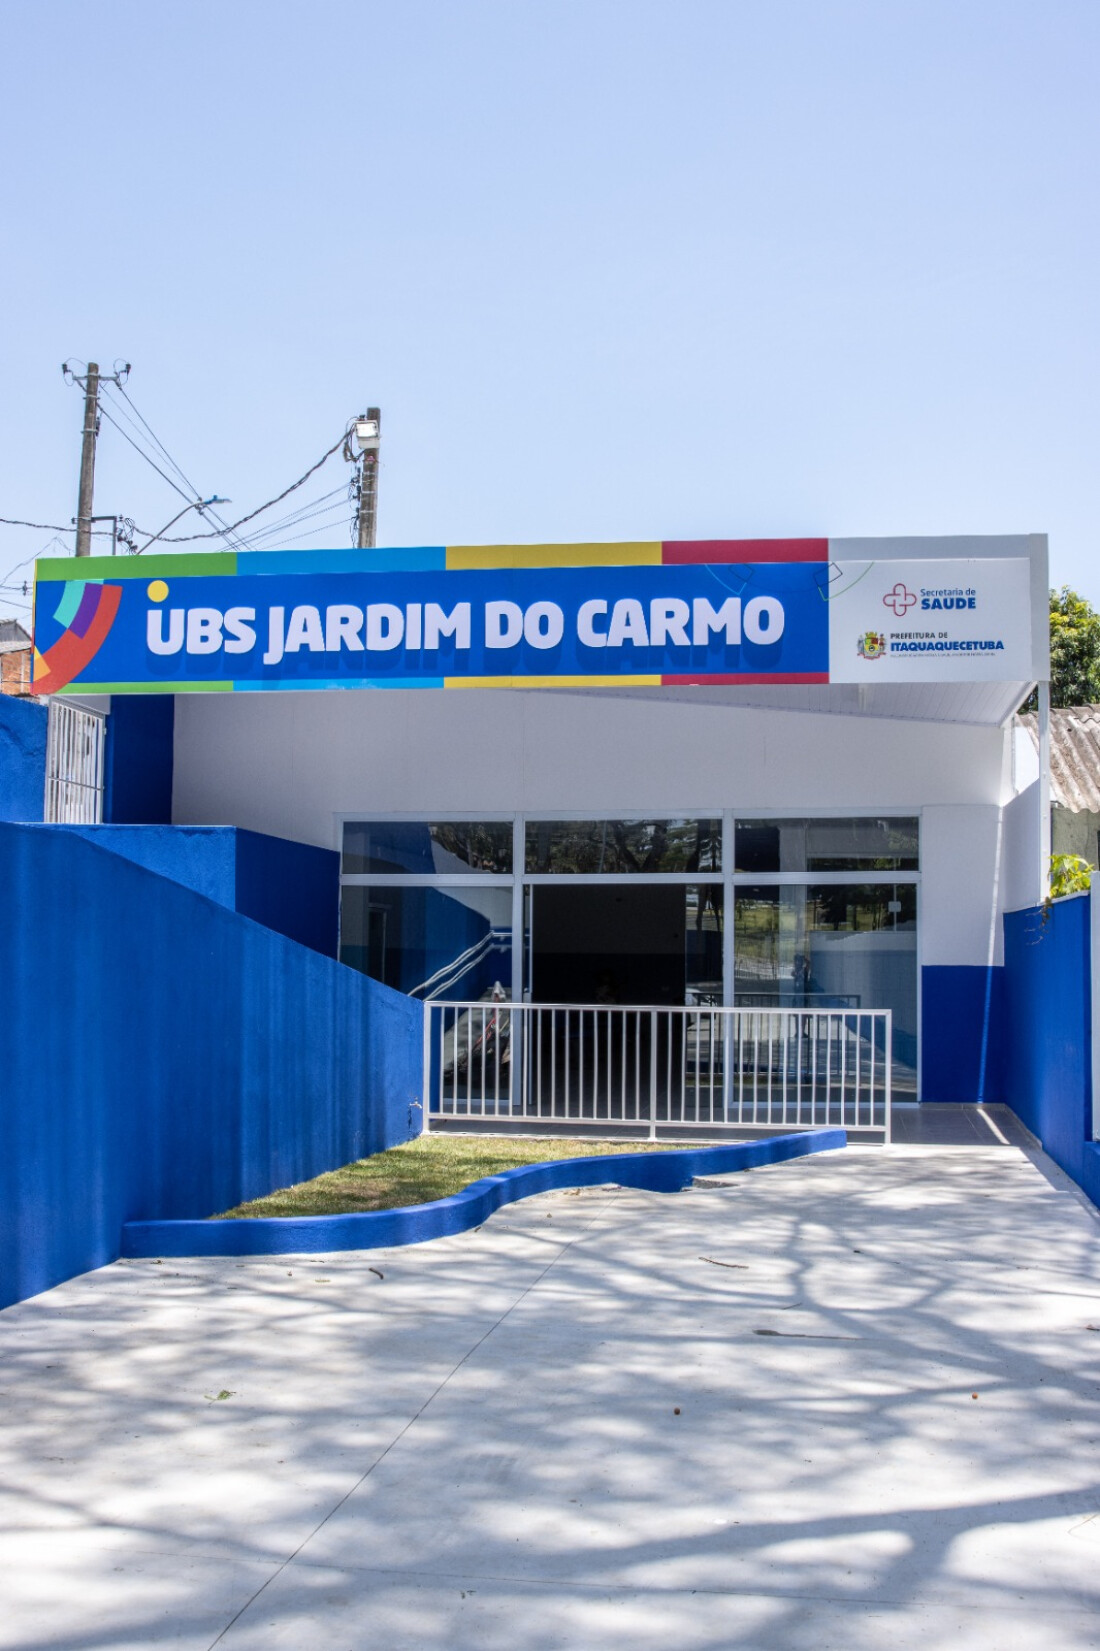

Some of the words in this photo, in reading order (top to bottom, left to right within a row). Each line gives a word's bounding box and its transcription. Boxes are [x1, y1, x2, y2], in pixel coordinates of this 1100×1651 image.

[920, 588, 963, 597] Secretaria
[965, 588, 976, 596] de
[146, 605, 257, 656] UBS
[263, 602, 472, 665] JARDIM
[485, 600, 564, 650] DO
[577, 595, 785, 649] CARMO
[890, 640, 1004, 651] ITAQUAQUECETUBA
